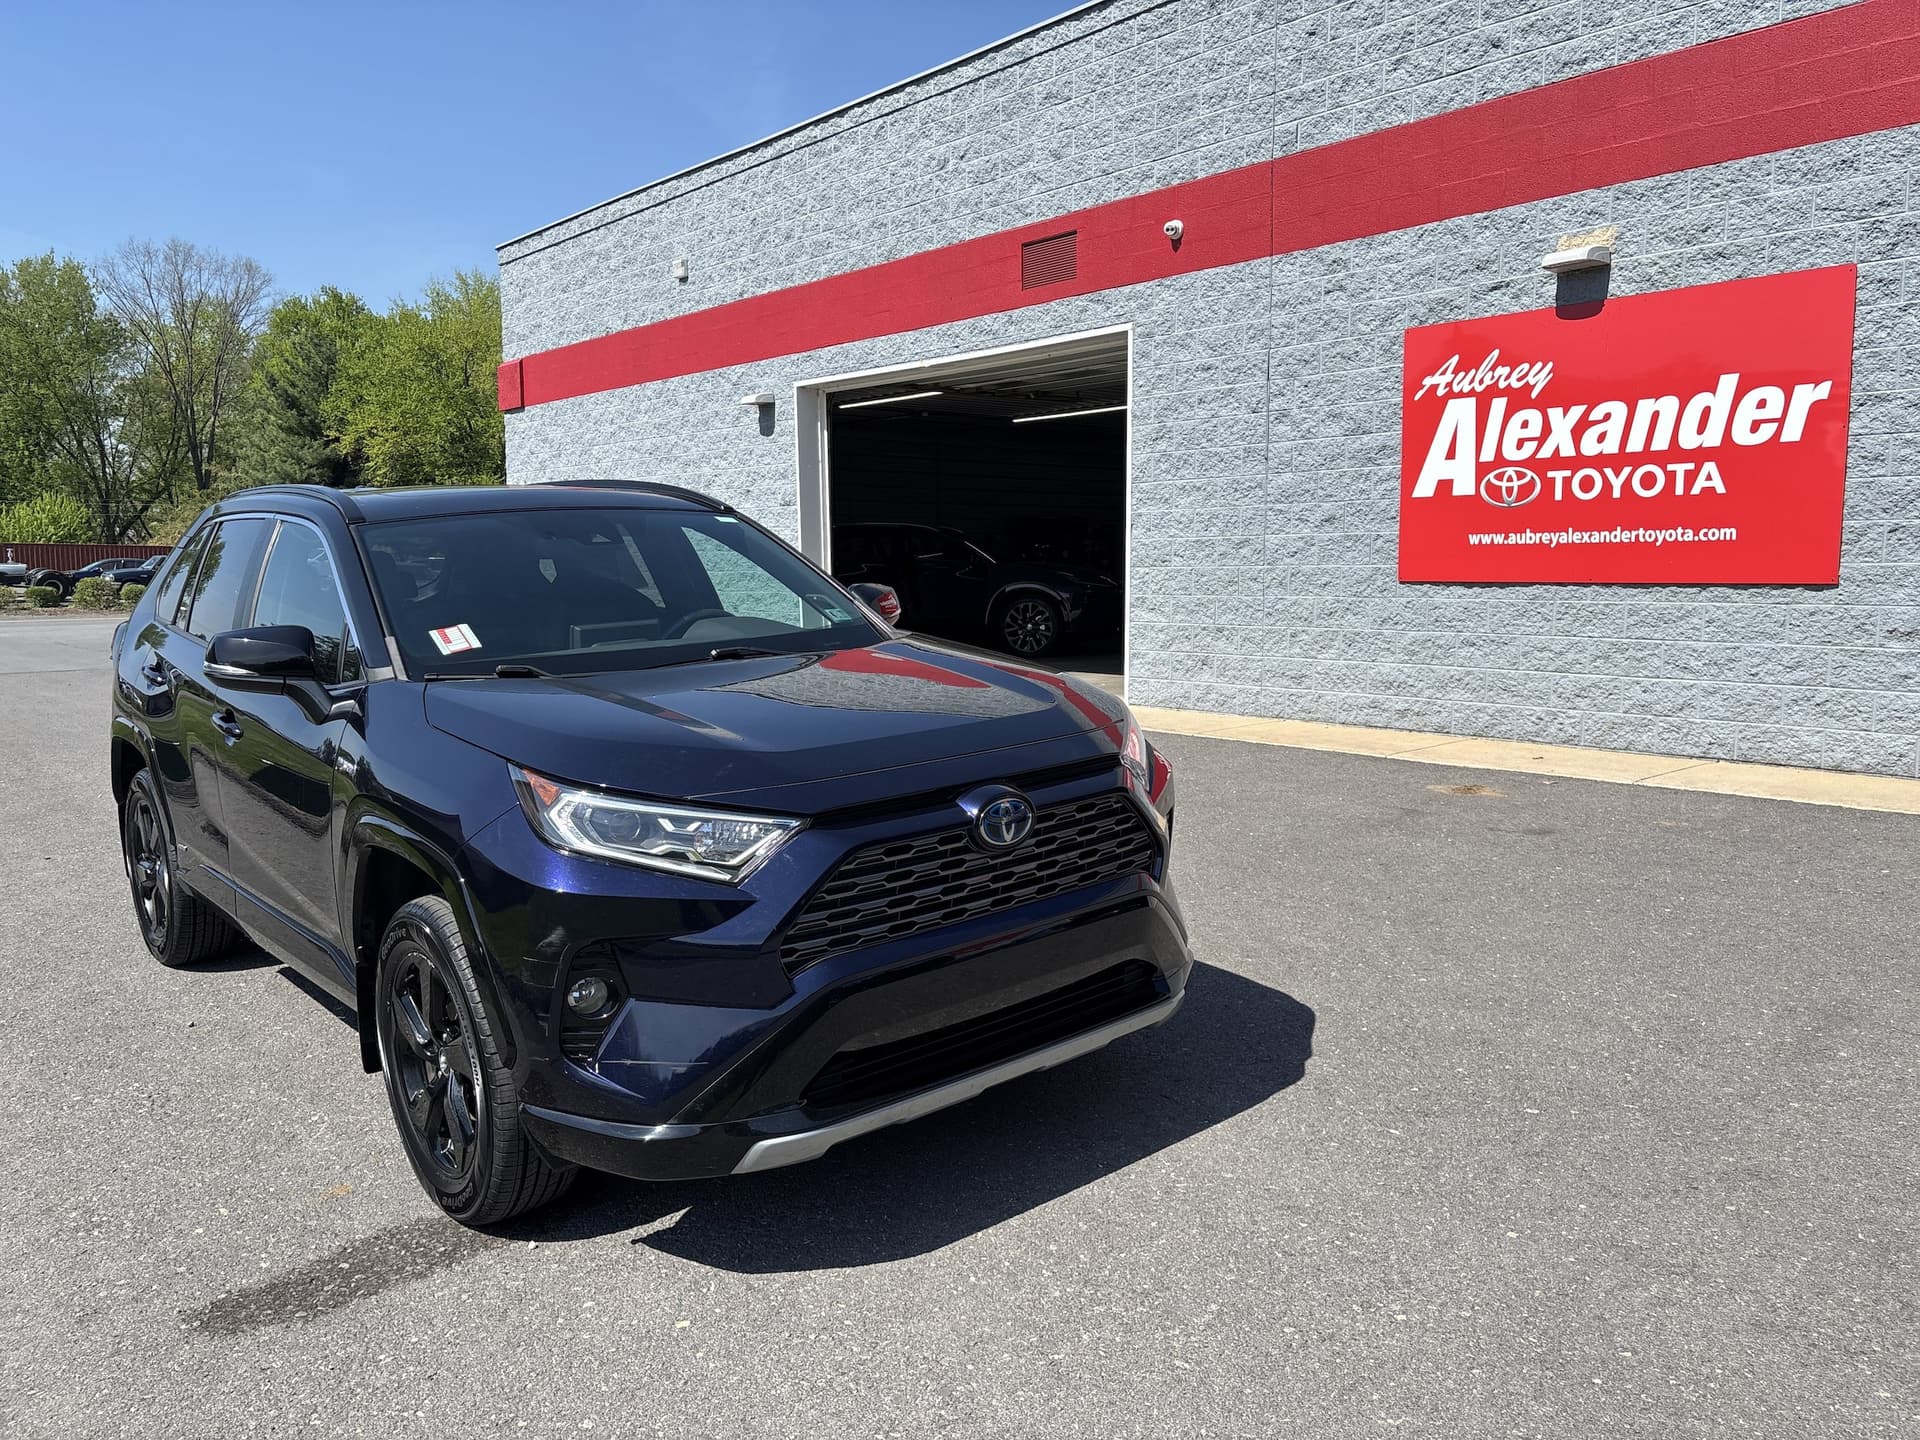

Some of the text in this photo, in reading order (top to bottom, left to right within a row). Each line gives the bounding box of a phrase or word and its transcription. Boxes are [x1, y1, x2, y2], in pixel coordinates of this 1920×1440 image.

[1413, 348, 1554, 401] Aubrey
[1410, 373, 1833, 498] Alexander
[1546, 461, 1727, 501] TOYOTA
[1468, 526, 1737, 548] www.aubreyalexandertoyota.com
